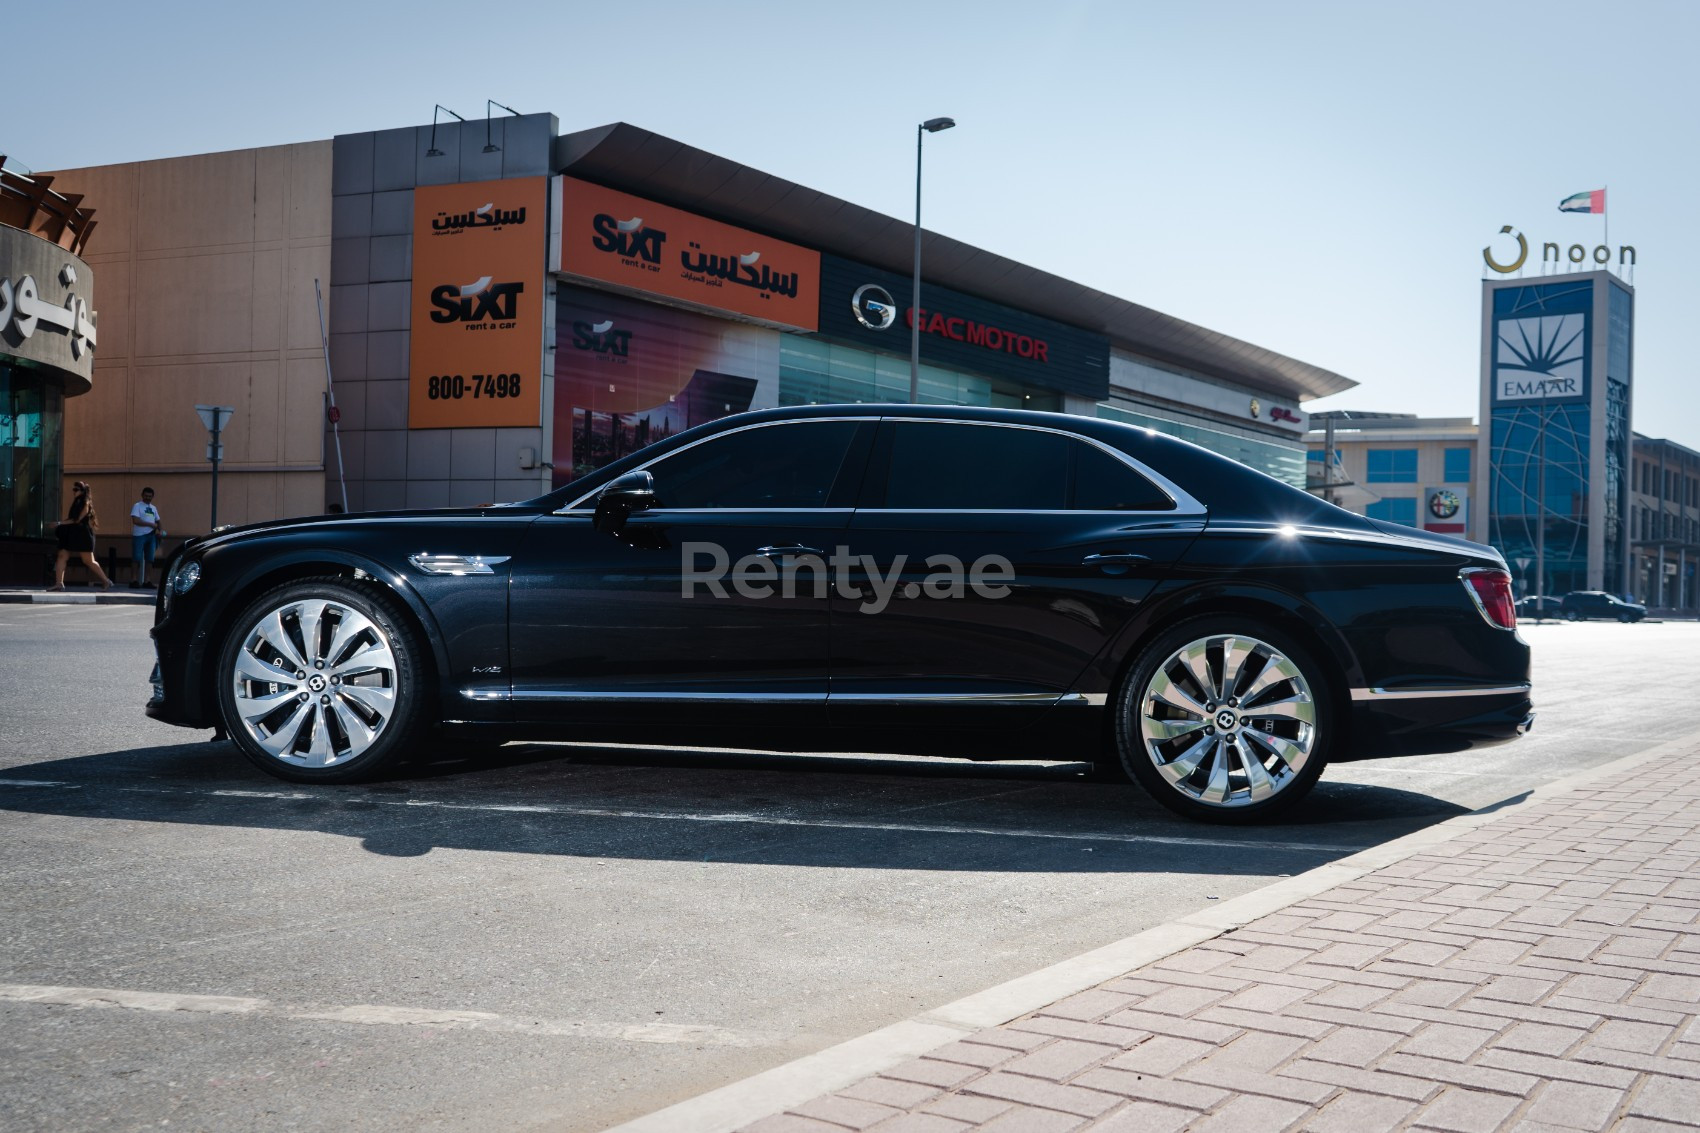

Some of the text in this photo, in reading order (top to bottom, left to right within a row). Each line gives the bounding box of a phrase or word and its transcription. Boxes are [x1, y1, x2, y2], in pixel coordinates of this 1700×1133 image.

[1543, 242, 1636, 265] noon
[622, 259, 639, 268] rent
[648, 264, 661, 272] car
[466, 322, 487, 330] rent
[499, 322, 516, 330] car
[428, 373, 521, 400] 800-7498
[1504, 378, 1576, 396] EMAAR
